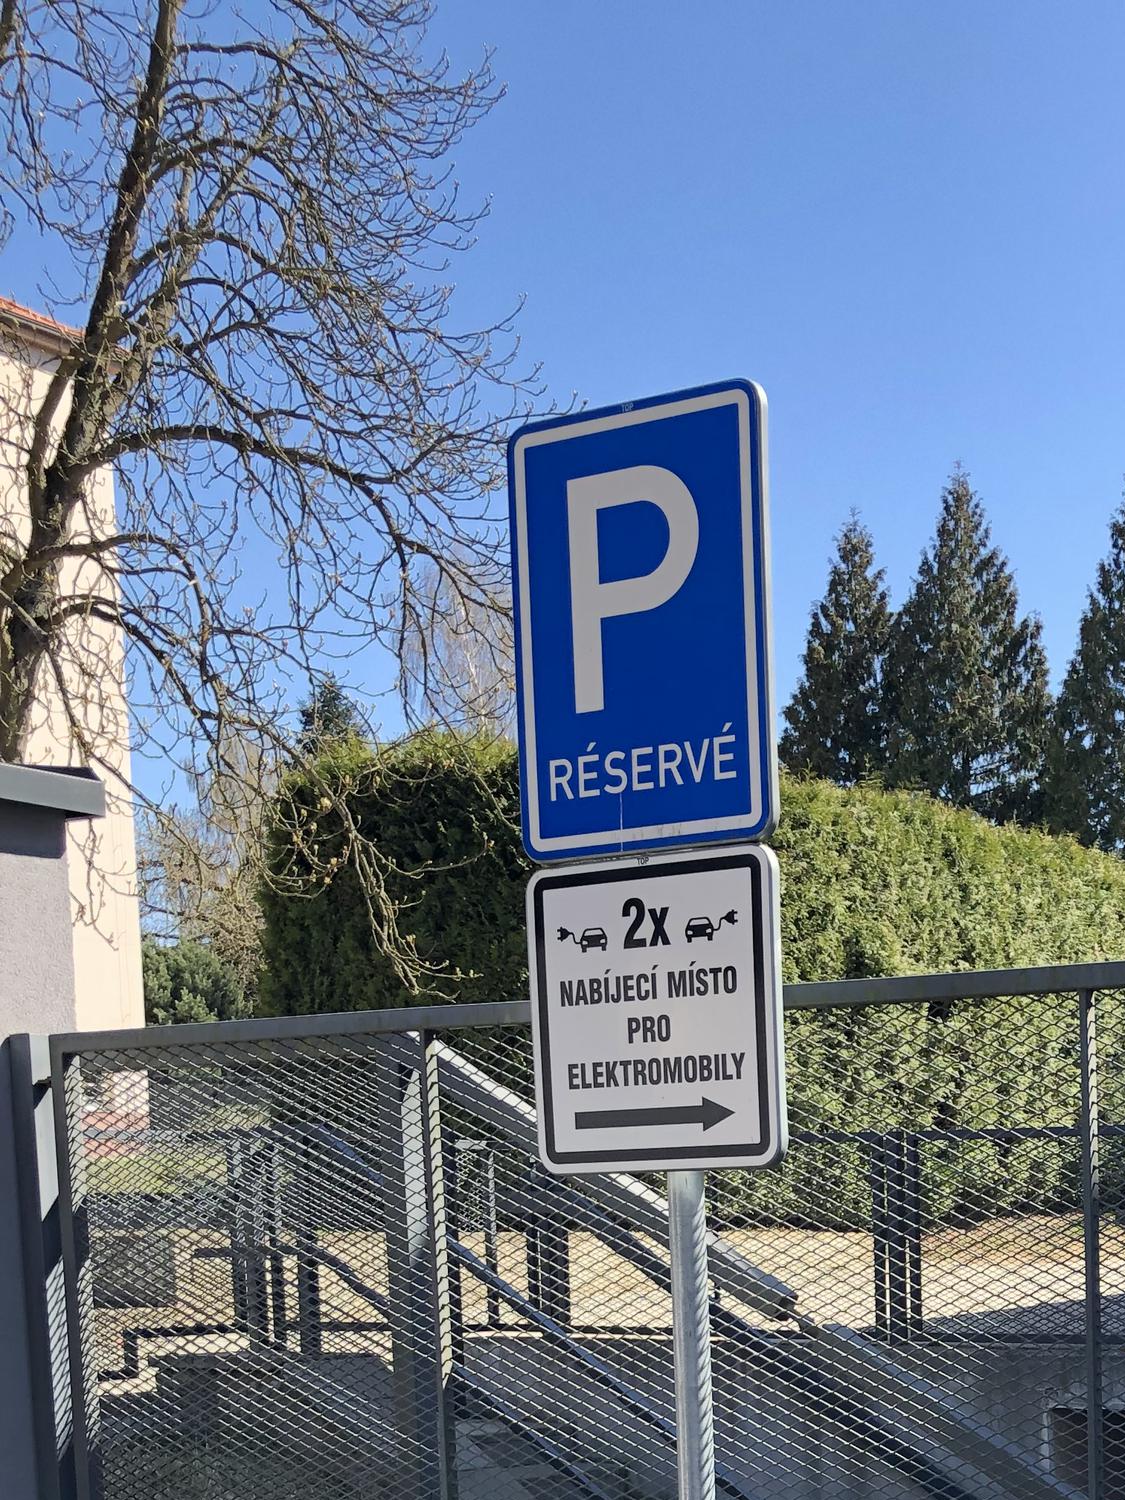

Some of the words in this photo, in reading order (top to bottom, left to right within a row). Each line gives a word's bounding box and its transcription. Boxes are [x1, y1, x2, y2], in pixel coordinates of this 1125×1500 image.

[567, 464, 700, 714] P
[549, 722, 738, 801] RÉSERVÉ
[637, 856, 650, 865] TOP
[621, 897, 671, 949] 2x
[560, 965, 658, 1007] NABÍJECÍ
[668, 961, 737, 998] MÍSTO
[627, 1014, 671, 1044] PRO
[568, 1052, 746, 1090] ELEKTROMOBILY
